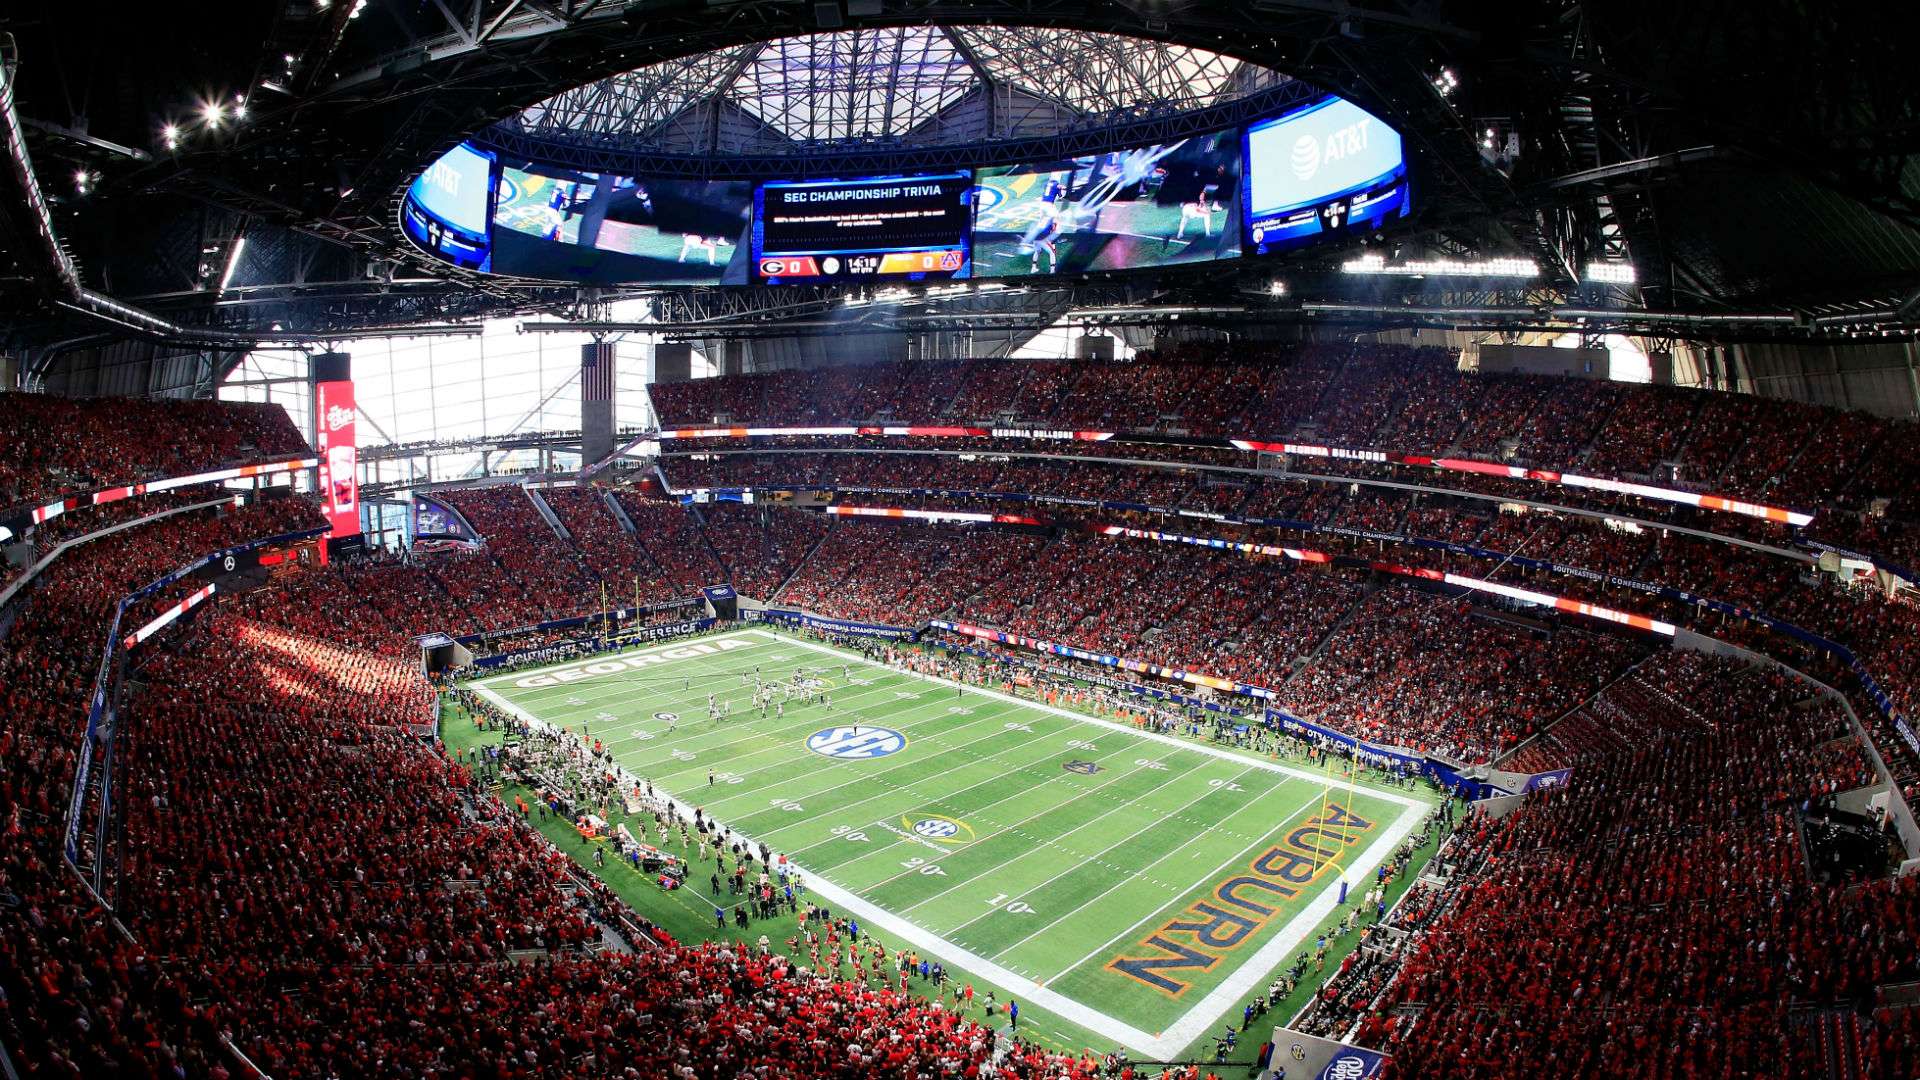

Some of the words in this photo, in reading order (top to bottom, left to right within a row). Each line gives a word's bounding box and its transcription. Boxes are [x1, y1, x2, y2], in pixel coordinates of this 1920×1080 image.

[1323, 118, 1371, 165] AT&T
[784, 192, 807, 203] SEC
[810, 187, 900, 202] CHAMPIONSHIP
[903, 185, 942, 198] TRIVIA
[1331, 448, 1387, 461] BULLDOGS
[1552, 564, 1602, 580] SOUTHEASTERN
[1611, 577, 1663, 594] CONFERENCE
[515, 638, 757, 689] GEORGIA
[830, 824, 864, 841] 30
[900, 856, 941, 876] 20
[985, 892, 1030, 914] 10
[1105, 802, 1377, 998] AUBURN
